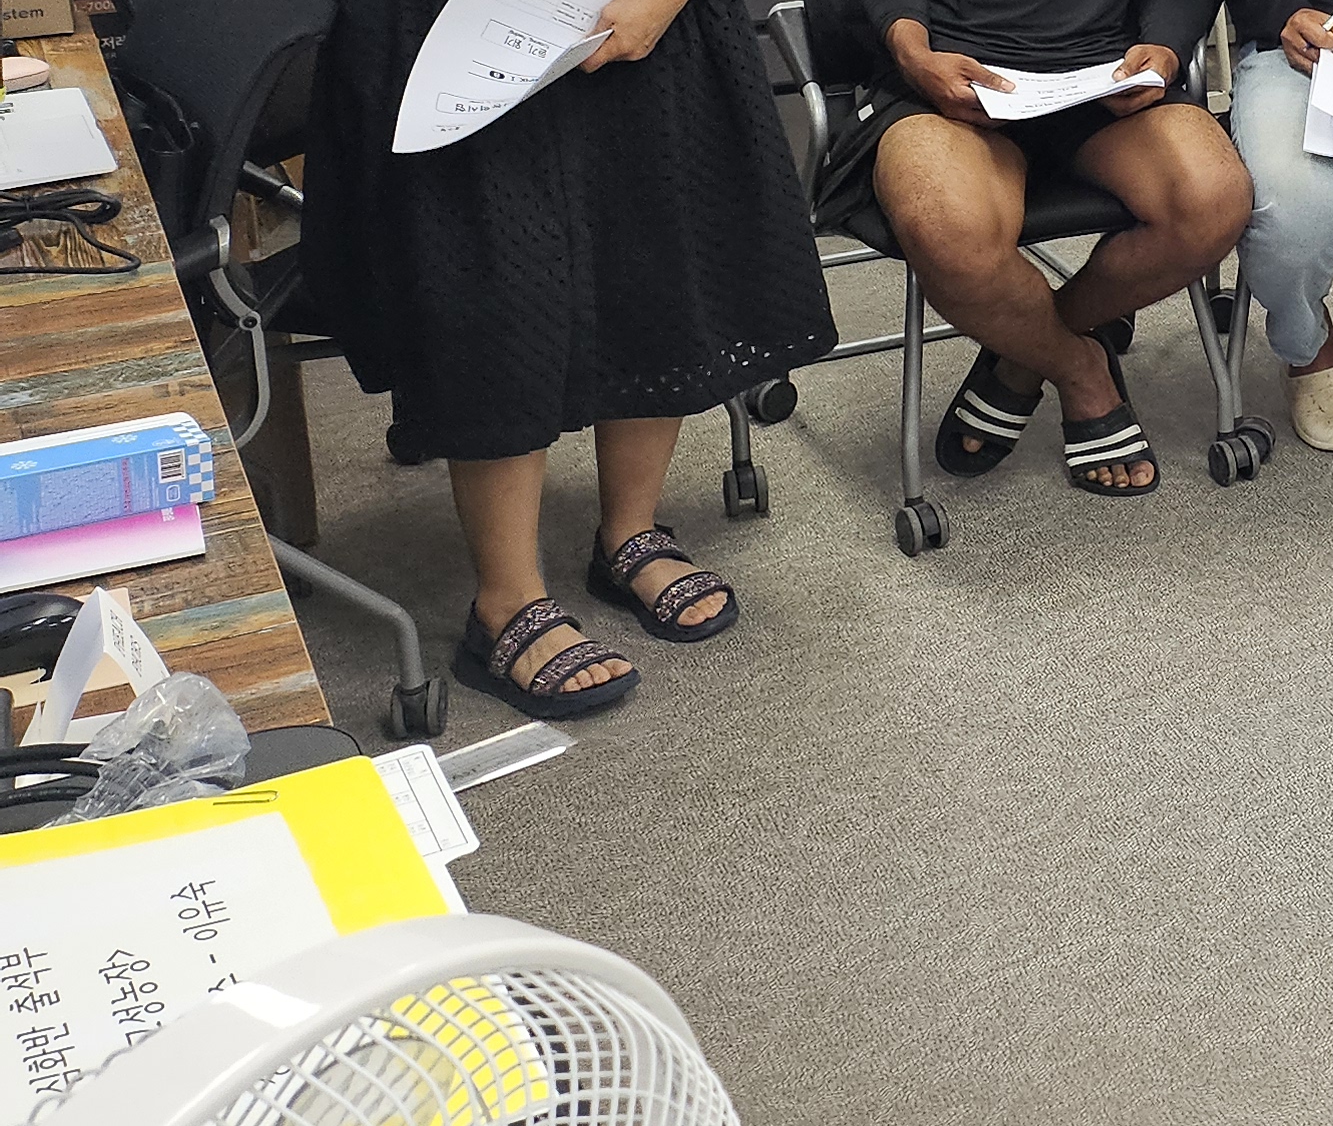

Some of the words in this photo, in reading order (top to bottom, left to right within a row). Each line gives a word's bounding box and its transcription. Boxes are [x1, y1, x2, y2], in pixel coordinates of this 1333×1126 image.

[504, 34, 522, 50] 읽기
[169, 879, 231, 942] 이유숙
[0, 946, 61, 1014] 출석부
